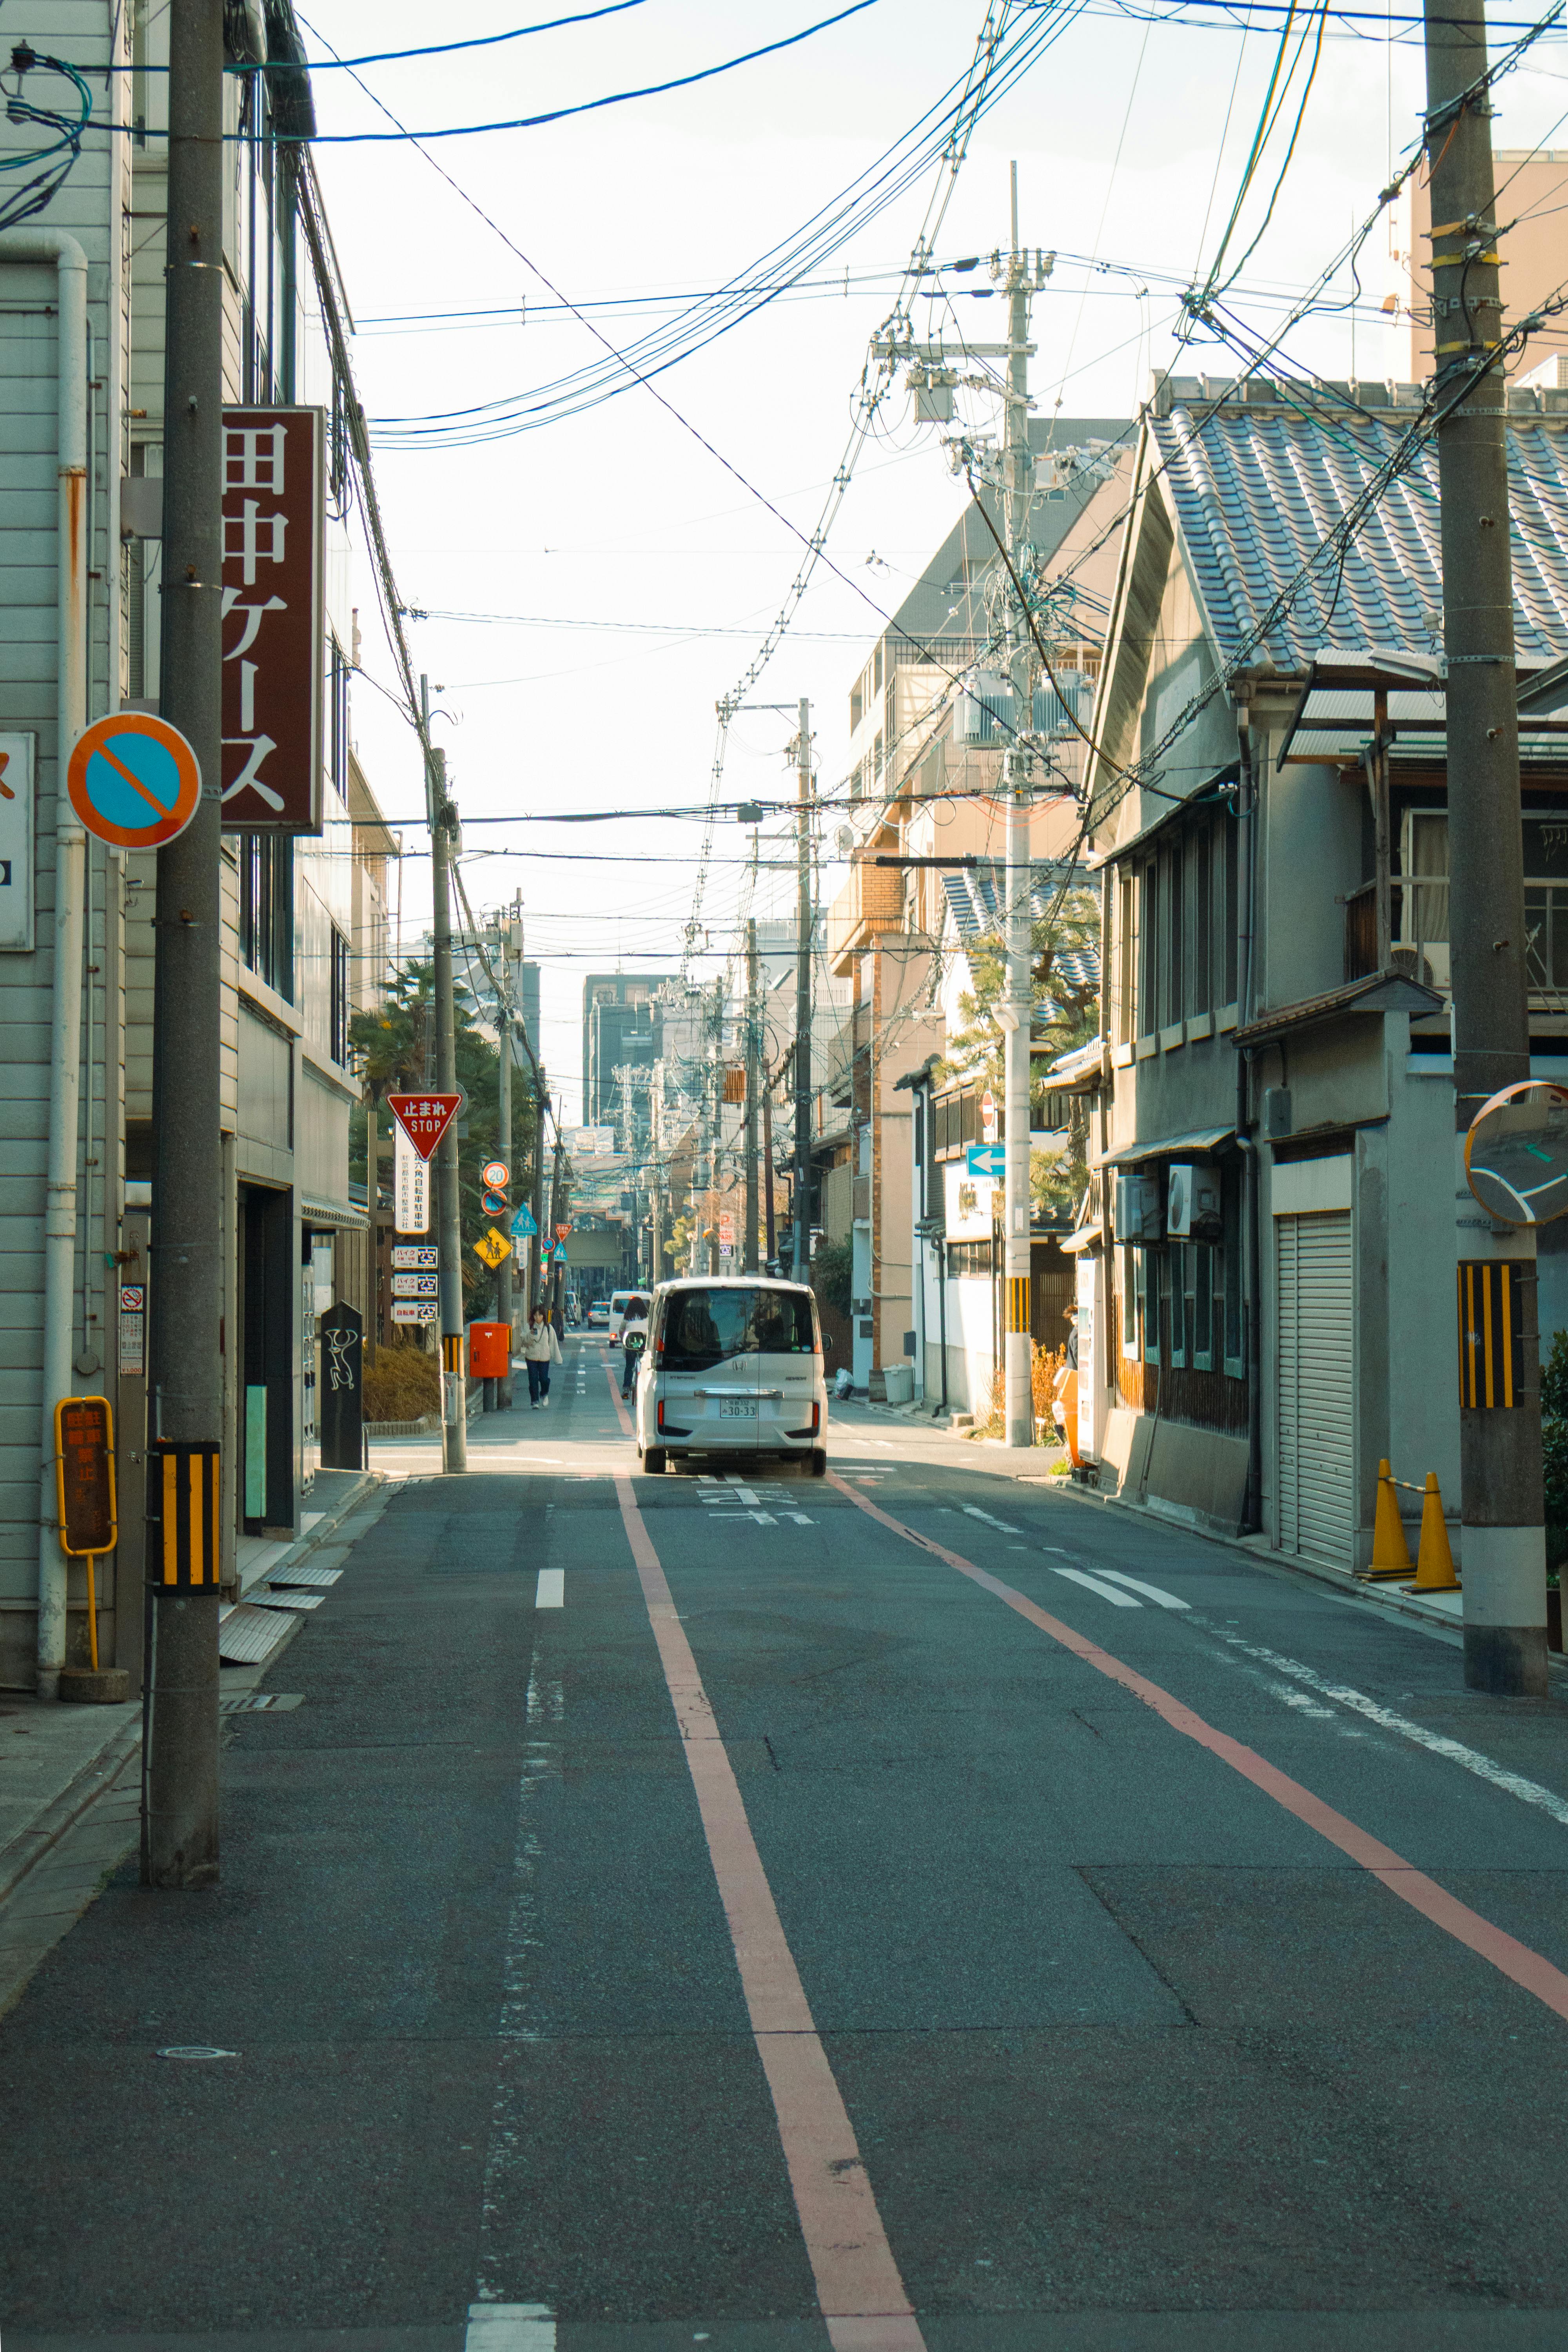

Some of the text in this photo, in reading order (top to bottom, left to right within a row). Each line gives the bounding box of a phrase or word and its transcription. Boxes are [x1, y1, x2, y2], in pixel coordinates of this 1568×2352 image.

[221, 423, 288, 812] 田中ケース
[403, 1101, 447, 1116] 止まれ
[411, 1120, 441, 1132] STOP
[489, 1170, 503, 1181] 20
[720, 1215, 730, 1226] P
[418, 1248, 436, 1267] 空
[417, 1276, 436, 1294] 空
[417, 1304, 436, 1322] 空
[728, 1406, 755, 1416] 30-33
